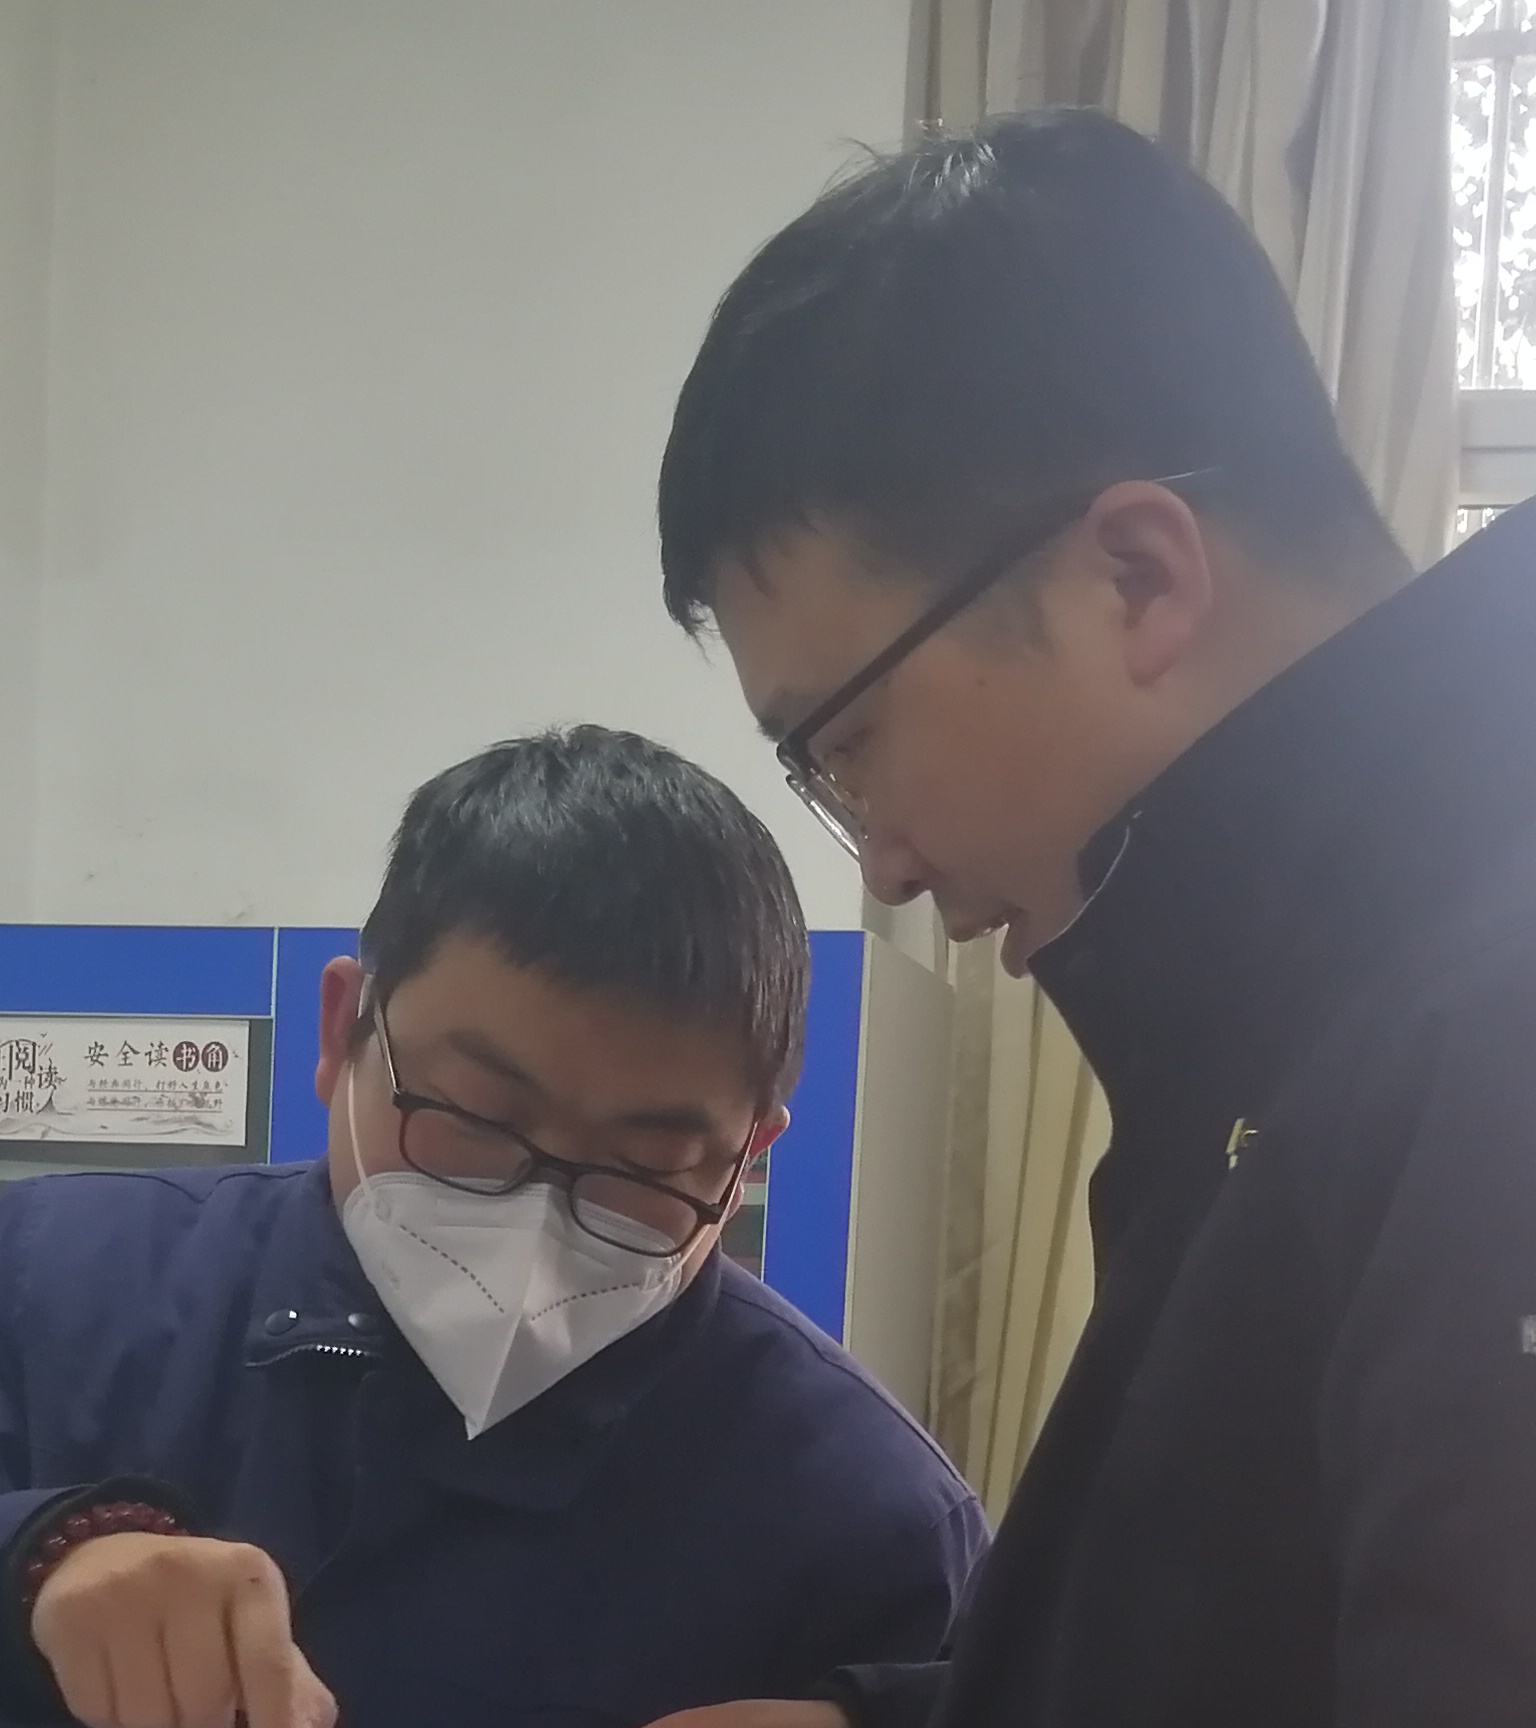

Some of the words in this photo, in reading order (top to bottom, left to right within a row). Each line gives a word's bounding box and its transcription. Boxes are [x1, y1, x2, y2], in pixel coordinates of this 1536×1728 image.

[84, 1040, 229, 1072] 安全读书角
